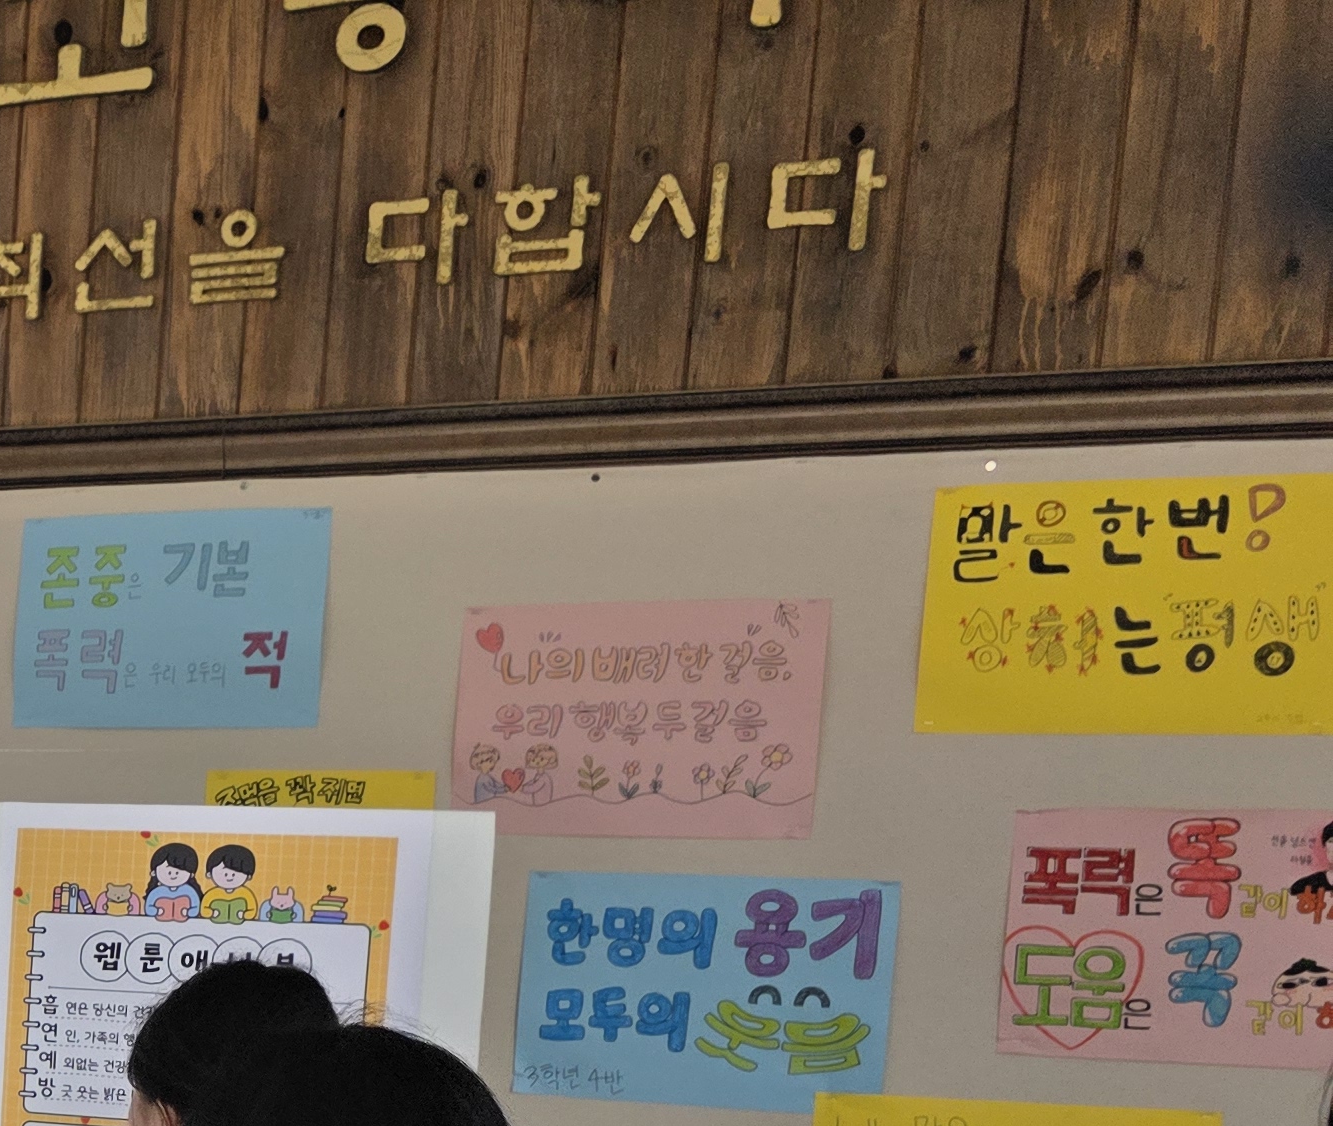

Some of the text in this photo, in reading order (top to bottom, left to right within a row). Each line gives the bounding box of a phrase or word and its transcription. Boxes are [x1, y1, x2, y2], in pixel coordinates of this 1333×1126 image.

[365, 147, 888, 286] 다합시다
[952, 499, 1075, 583] 말은
[41, 540, 249, 609] 존중은 기본
[34, 628, 137, 694] 폭력은
[149, 663, 175, 685] 우리
[242, 631, 288, 689] 적
[499, 648, 585, 684] 나의
[592, 642, 671, 683] 배려
[675, 643, 712, 683] 한
[492, 699, 767, 745] 우리 행복 두 걸음
[1022, 846, 1163, 917] 폭력은
[735, 889, 882, 980] 용기
[42, 995, 128, 1017] 흡 연은 당신의
[1012, 943, 1151, 1031] 도움은
[1165, 932, 1242, 1028] 꼭
[39, 1051, 99, 1072] 예 외없는
[41, 1023, 57, 1042] 연
[85, 1032, 119, 1044] 가족의
[539, 986, 870, 1075] 모두의 웃음
[39, 1078, 126, 1101] 방 긋 웃는 밝은
[524, 1065, 624, 1095] 3학년 4반
